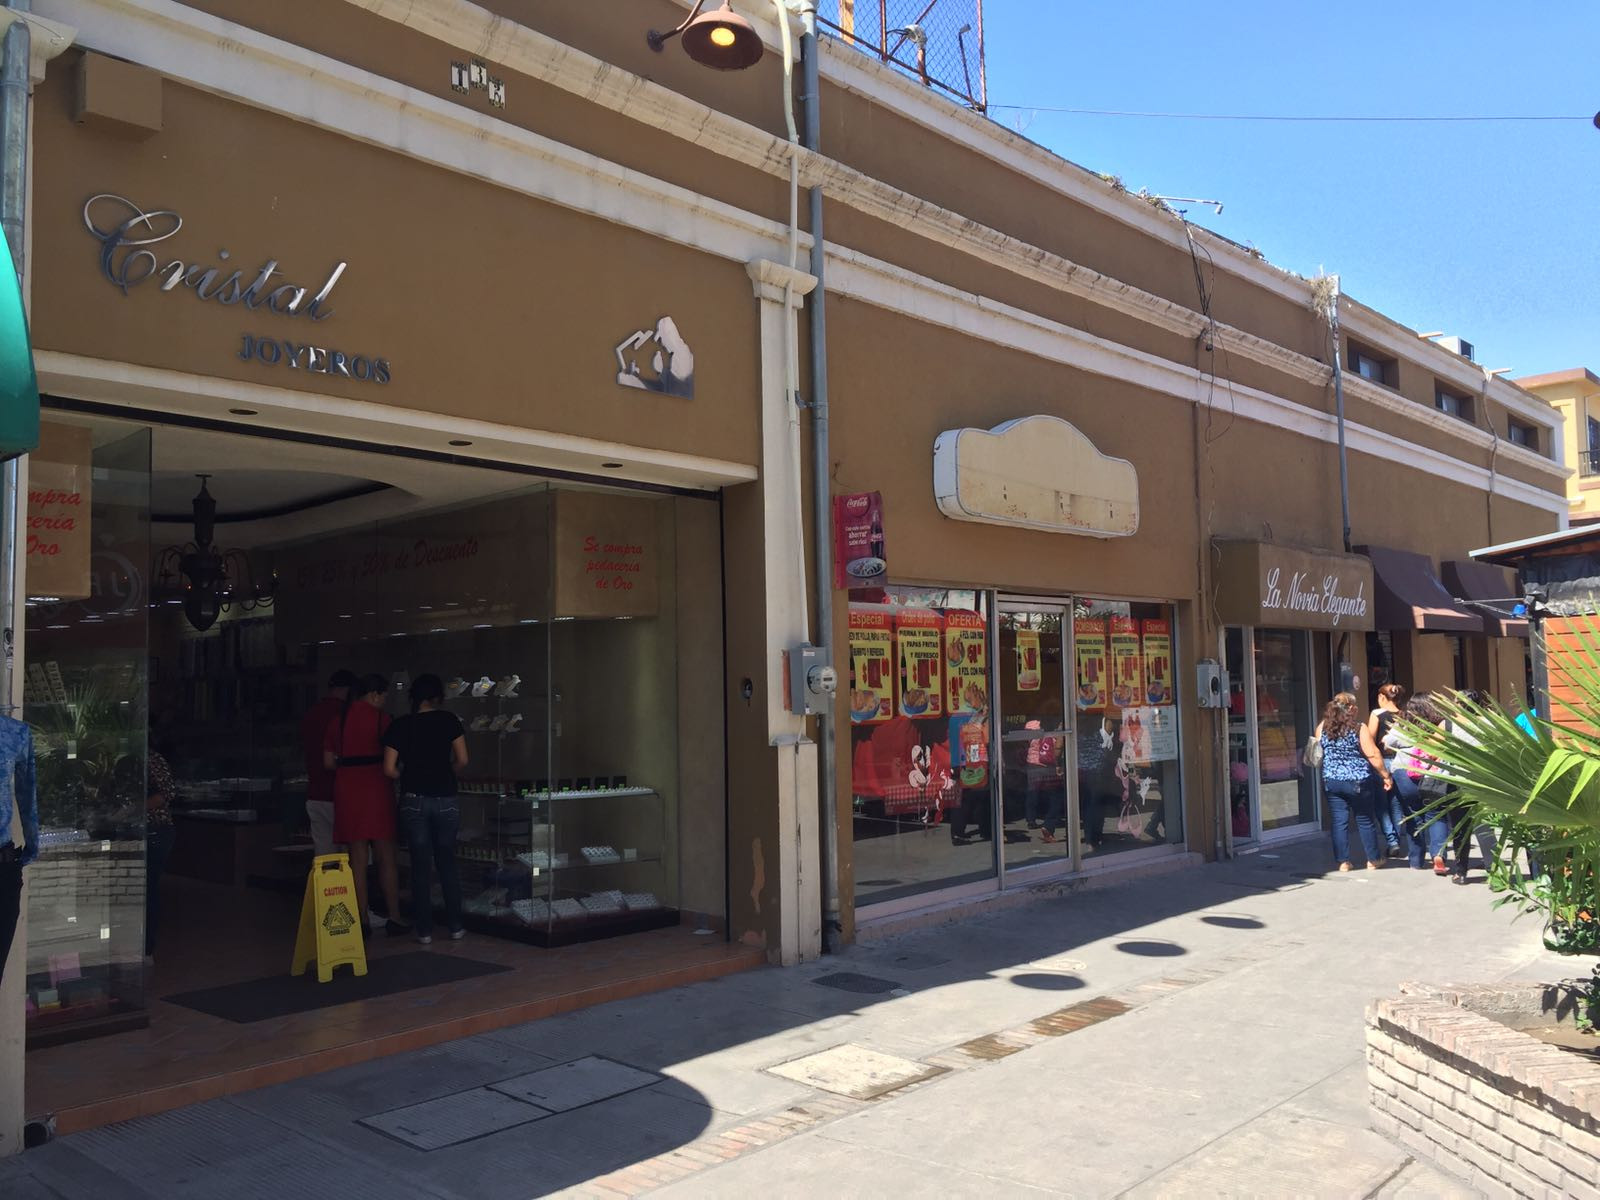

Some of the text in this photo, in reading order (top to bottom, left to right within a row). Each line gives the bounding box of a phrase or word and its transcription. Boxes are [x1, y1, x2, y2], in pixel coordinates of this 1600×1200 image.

[84, 194, 348, 321] Cristal
[237, 332, 392, 385] JOYEROS
[413, 535, 479, 568] Descuento
[583, 535, 643, 557] Se compra
[595, 575, 633, 591] de Oro
[1262, 567, 1367, 626] La Novia Elegante
[851, 611, 885, 628] Especial
[948, 613, 982, 627] OFERTA
[323, 886, 348, 897] CAUTION
